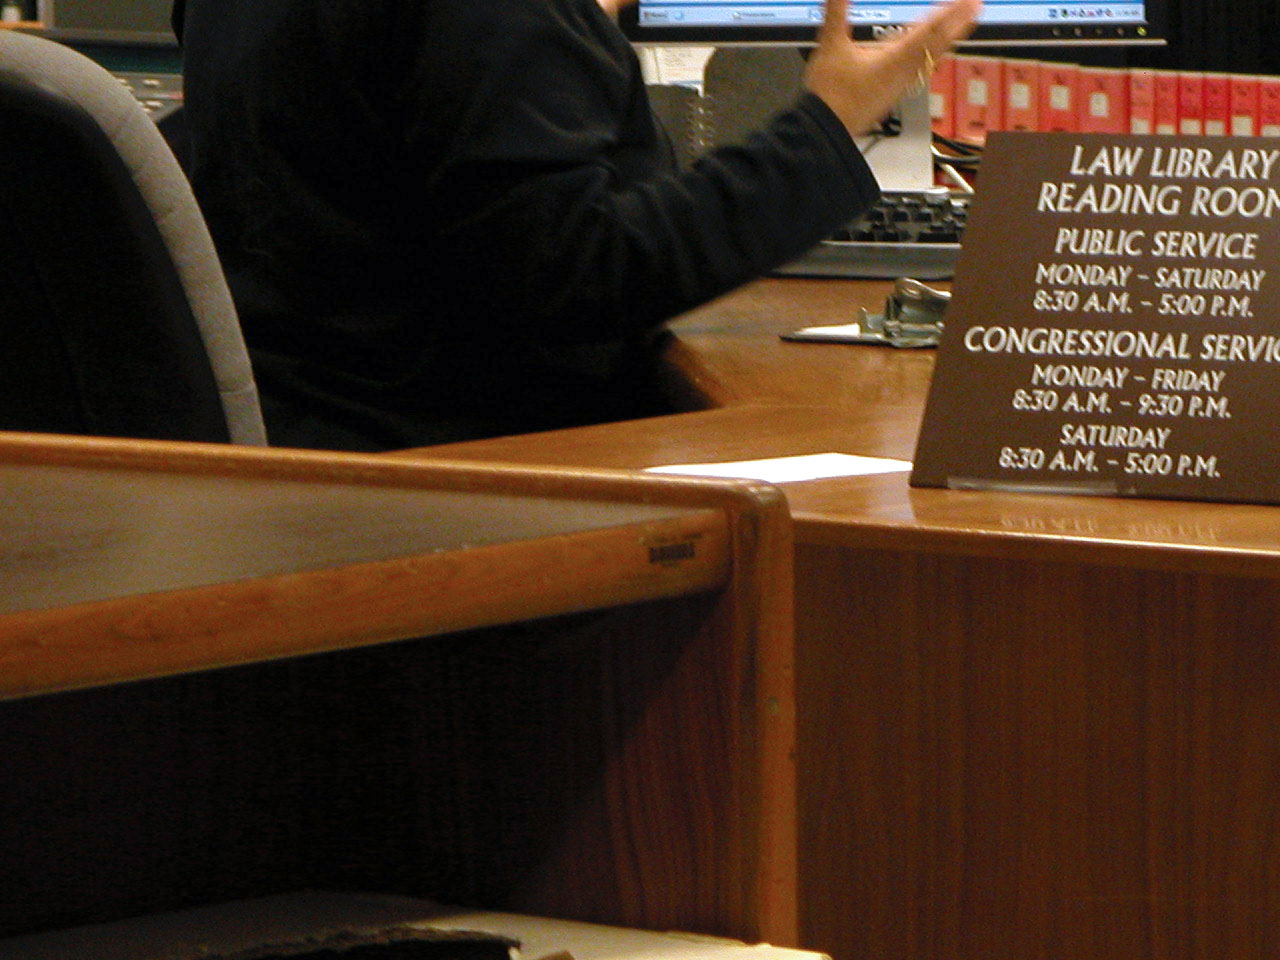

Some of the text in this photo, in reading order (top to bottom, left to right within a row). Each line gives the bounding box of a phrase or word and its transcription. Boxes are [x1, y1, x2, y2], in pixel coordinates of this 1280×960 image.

[1071, 146, 1280, 179] LAW LIBRARY
[1038, 183, 1182, 215] READING
[1055, 228, 1258, 259] PUBLIC SERVICE
[1036, 263, 1132, 286] MONDAY
[1155, 268, 1265, 290] SATURDAY
[1034, 290, 1078, 311] 8:30
[1083, 292, 1132, 313] A.M.
[1159, 294, 1205, 315] 5:00
[1211, 296, 1253, 317] P.M.
[965, 327, 1190, 359] CONGRESSIONAL
[1032, 365, 1129, 387] MONDAY
[1152, 369, 1225, 391] FRIDAY
[1013, 390, 1058, 410] 8:30
[1062, 392, 1111, 413] A.M.
[1139, 394, 1183, 415] 9:30
[1188, 396, 1230, 417] P.M.
[1060, 424, 1170, 448] SATURDAY
[1000, 447, 1044, 469] 8:30
[1049, 450, 1098, 471] A.M.
[1125, 453, 1172, 474] 5:00
[1177, 455, 1220, 477] P.M.
